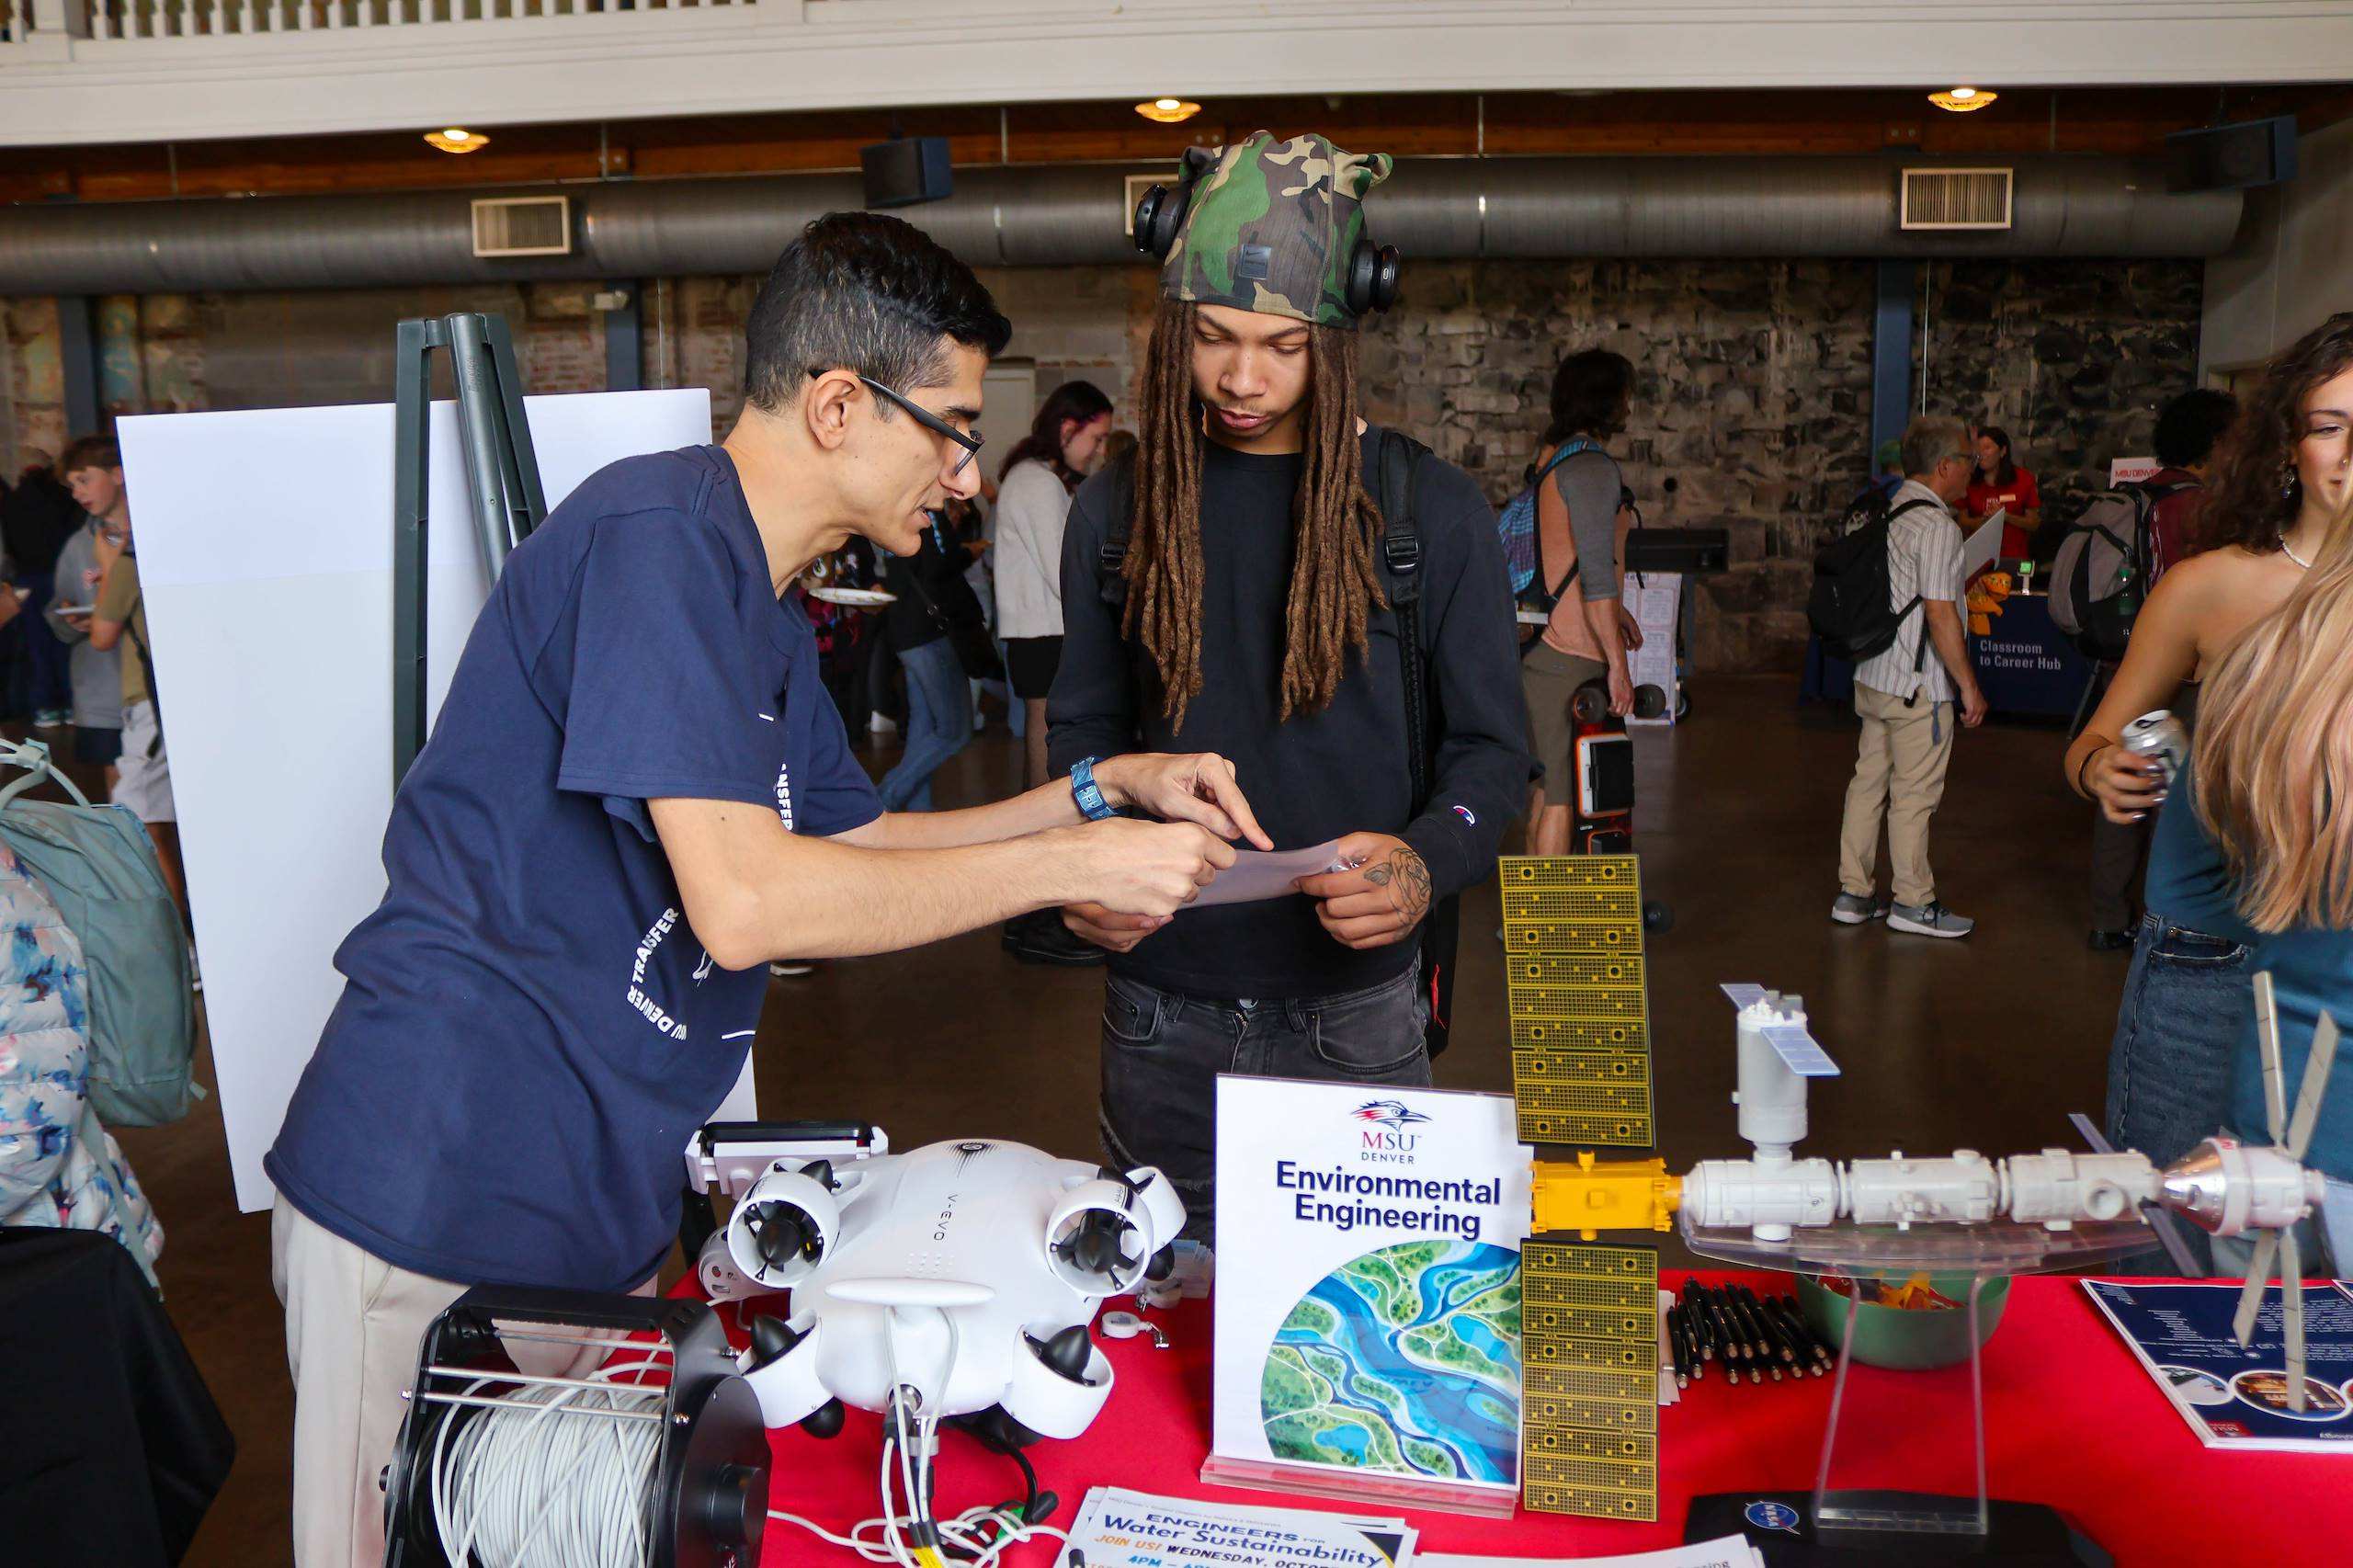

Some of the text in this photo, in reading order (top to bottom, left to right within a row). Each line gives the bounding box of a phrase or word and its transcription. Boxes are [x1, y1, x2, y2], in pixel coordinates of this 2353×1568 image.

[1979, 640, 2042, 655] Classroom
[1979, 654, 2062, 671] to Career Hub
[626, 984, 676, 1033] DENVER
[1361, 1131, 1415, 1152] MSU
[1360, 1152, 1415, 1165] DENVER
[1277, 1160, 1501, 1206] Environmental
[933, 1194, 959, 1241] V-EVO
[1295, 1193, 1481, 1242] Engineering
[1145, 1514, 1301, 1542] ENGINEERS
[1094, 1534, 1131, 1547] JOIN
[1134, 1540, 1163, 1551] US!
[1103, 1514, 1385, 1568] Water Sustainability
[1127, 1554, 1163, 1568] 4PM
